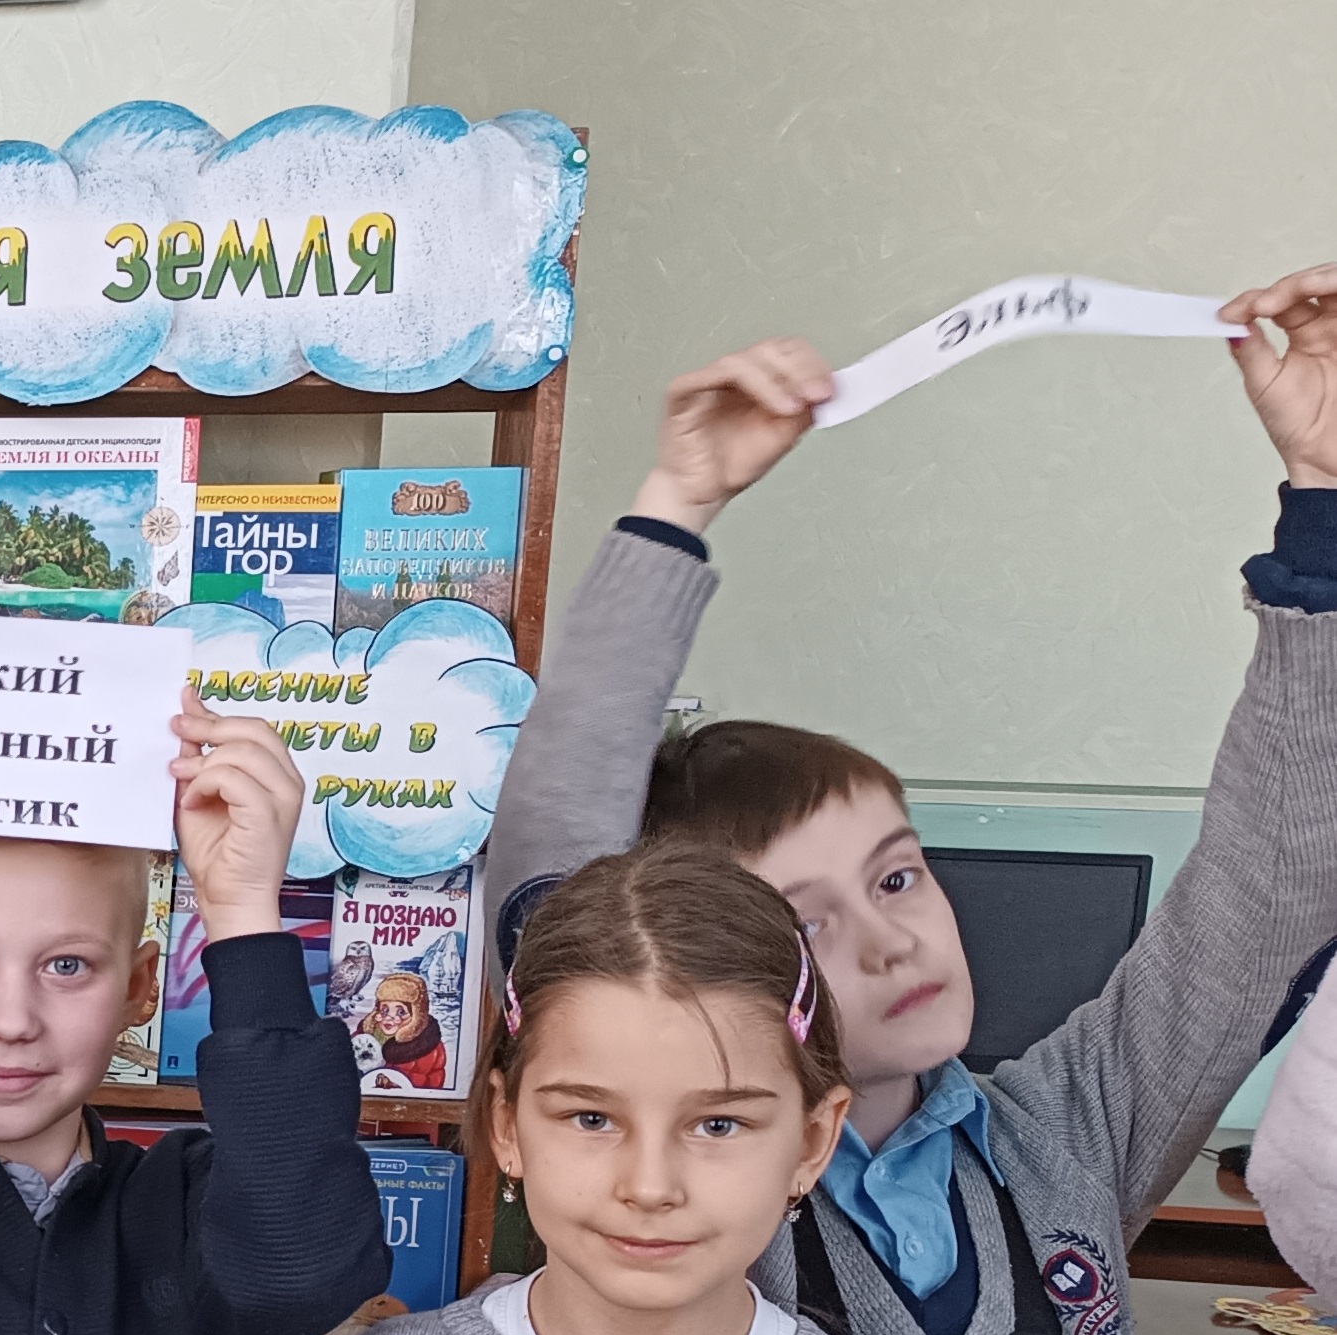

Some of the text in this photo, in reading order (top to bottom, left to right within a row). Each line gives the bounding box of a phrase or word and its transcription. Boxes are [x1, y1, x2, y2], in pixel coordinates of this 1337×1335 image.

[66, 438, 99, 446] ДЕТСКАЯ
[101, 438, 161, 446] ЭНЦИКЛОПЕДИЯ
[57, 451, 69, 463] И
[74, 450, 160, 463] ОКЕАНЫ
[195, 495, 337, 505] НТЕРЕСНО О НЕИЗВЕСТНОМ
[410, 492, 446, 511] 100
[196, 511, 318, 548] Тайны
[364, 528, 489, 551] ВЕЛИКИХ
[225, 549, 293, 587] гор
[341, 557, 506, 580] ЗАПОВЕДНИКОВ
[371, 582, 473, 600] И ПАРКОВ
[409, 722, 437, 753] В
[312, 775, 456, 808] РУКАХ
[342, 900, 457, 927] Я ПОЗНАЮ
[372, 926, 420, 947] МИР
[408, 1180, 446, 1190] ФАКТЫ
